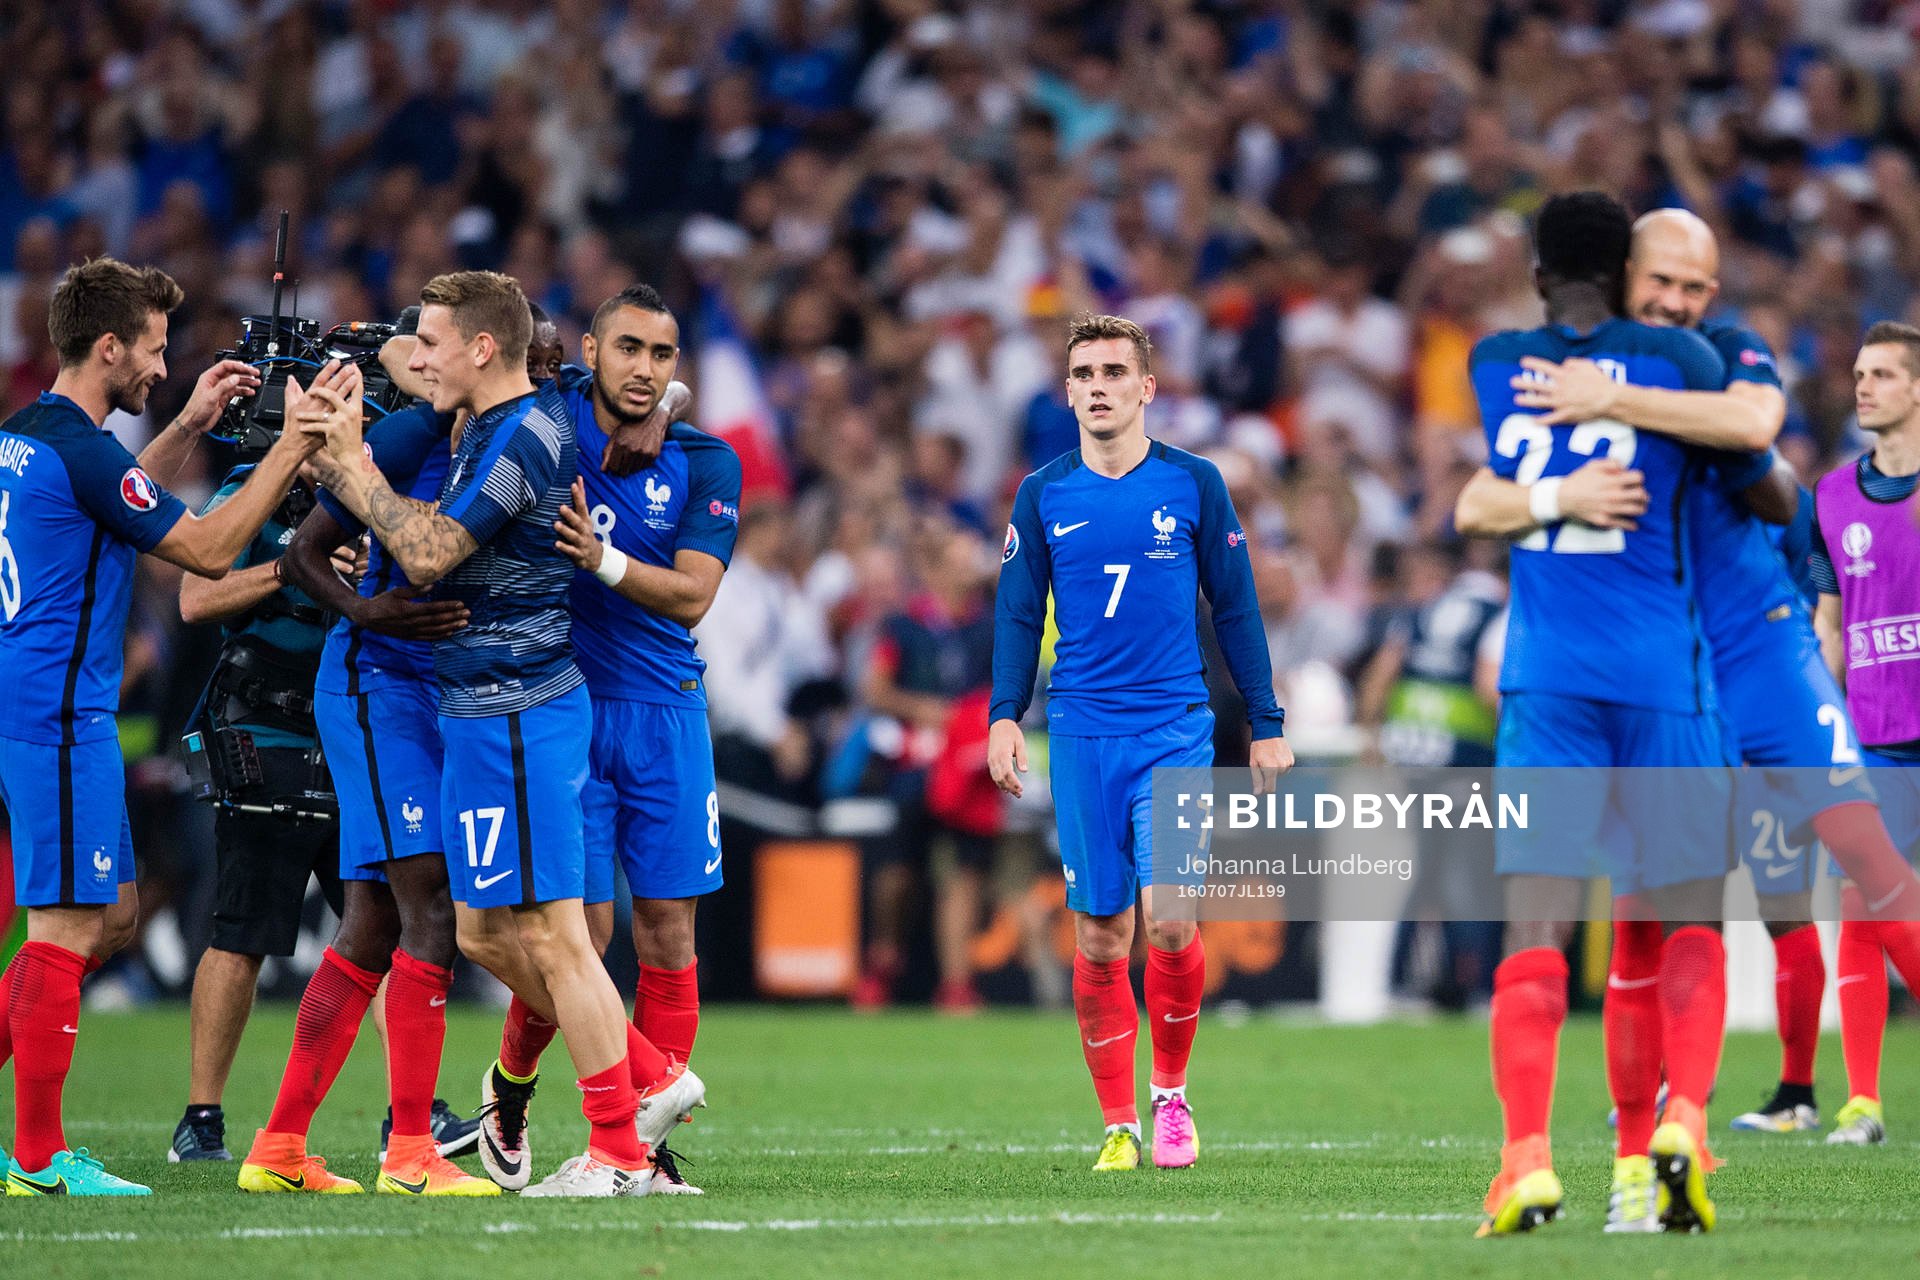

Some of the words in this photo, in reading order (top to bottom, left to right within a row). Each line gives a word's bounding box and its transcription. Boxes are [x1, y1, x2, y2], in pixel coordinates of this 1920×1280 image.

[1496, 412, 1637, 554] 22
[1104, 565, 1131, 618] 7
[1872, 623, 1920, 654] RES
[1817, 704, 1859, 764] 2
[460, 807, 505, 867] 17
[706, 791, 719, 848] 8
